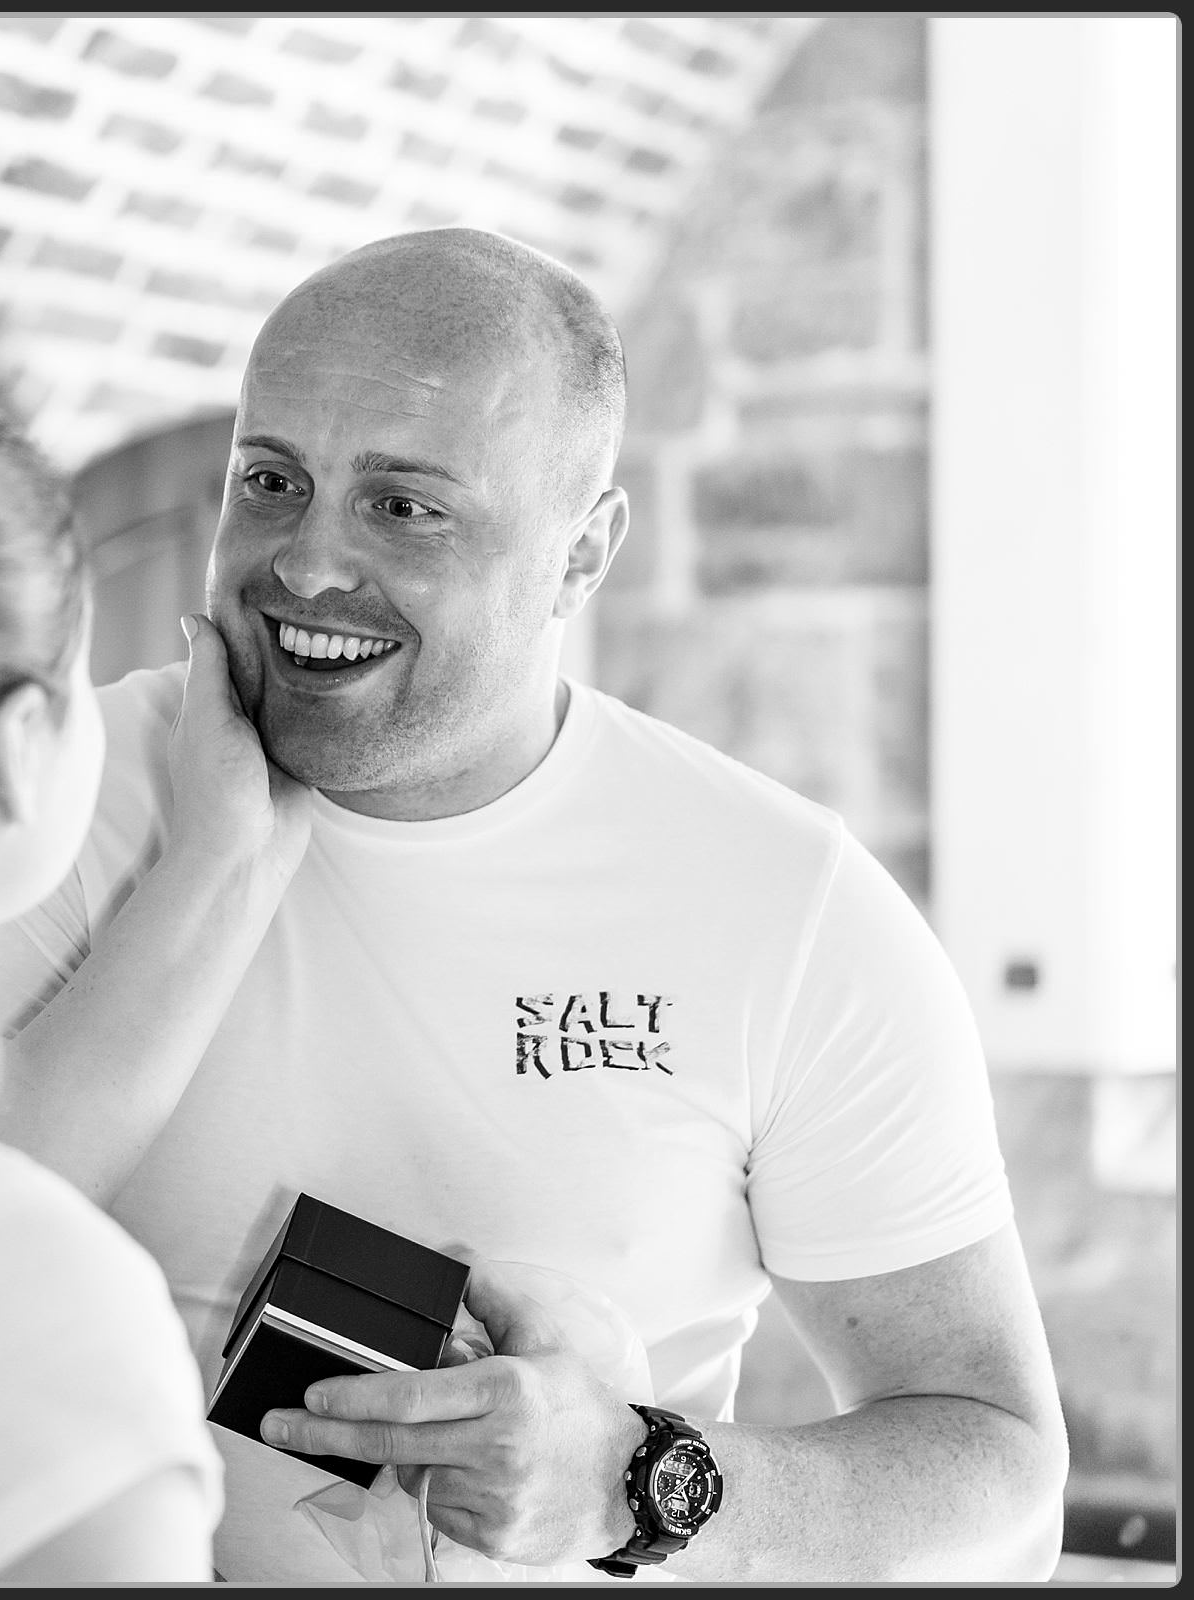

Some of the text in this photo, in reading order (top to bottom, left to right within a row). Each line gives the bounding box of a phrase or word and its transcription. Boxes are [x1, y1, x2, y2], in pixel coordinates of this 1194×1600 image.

[516, 991, 673, 1033] SALT
[516, 1032, 673, 1079] ROCK
[671, 1509, 680, 1518] 12
[668, 1523, 692, 1535] SKMEI
